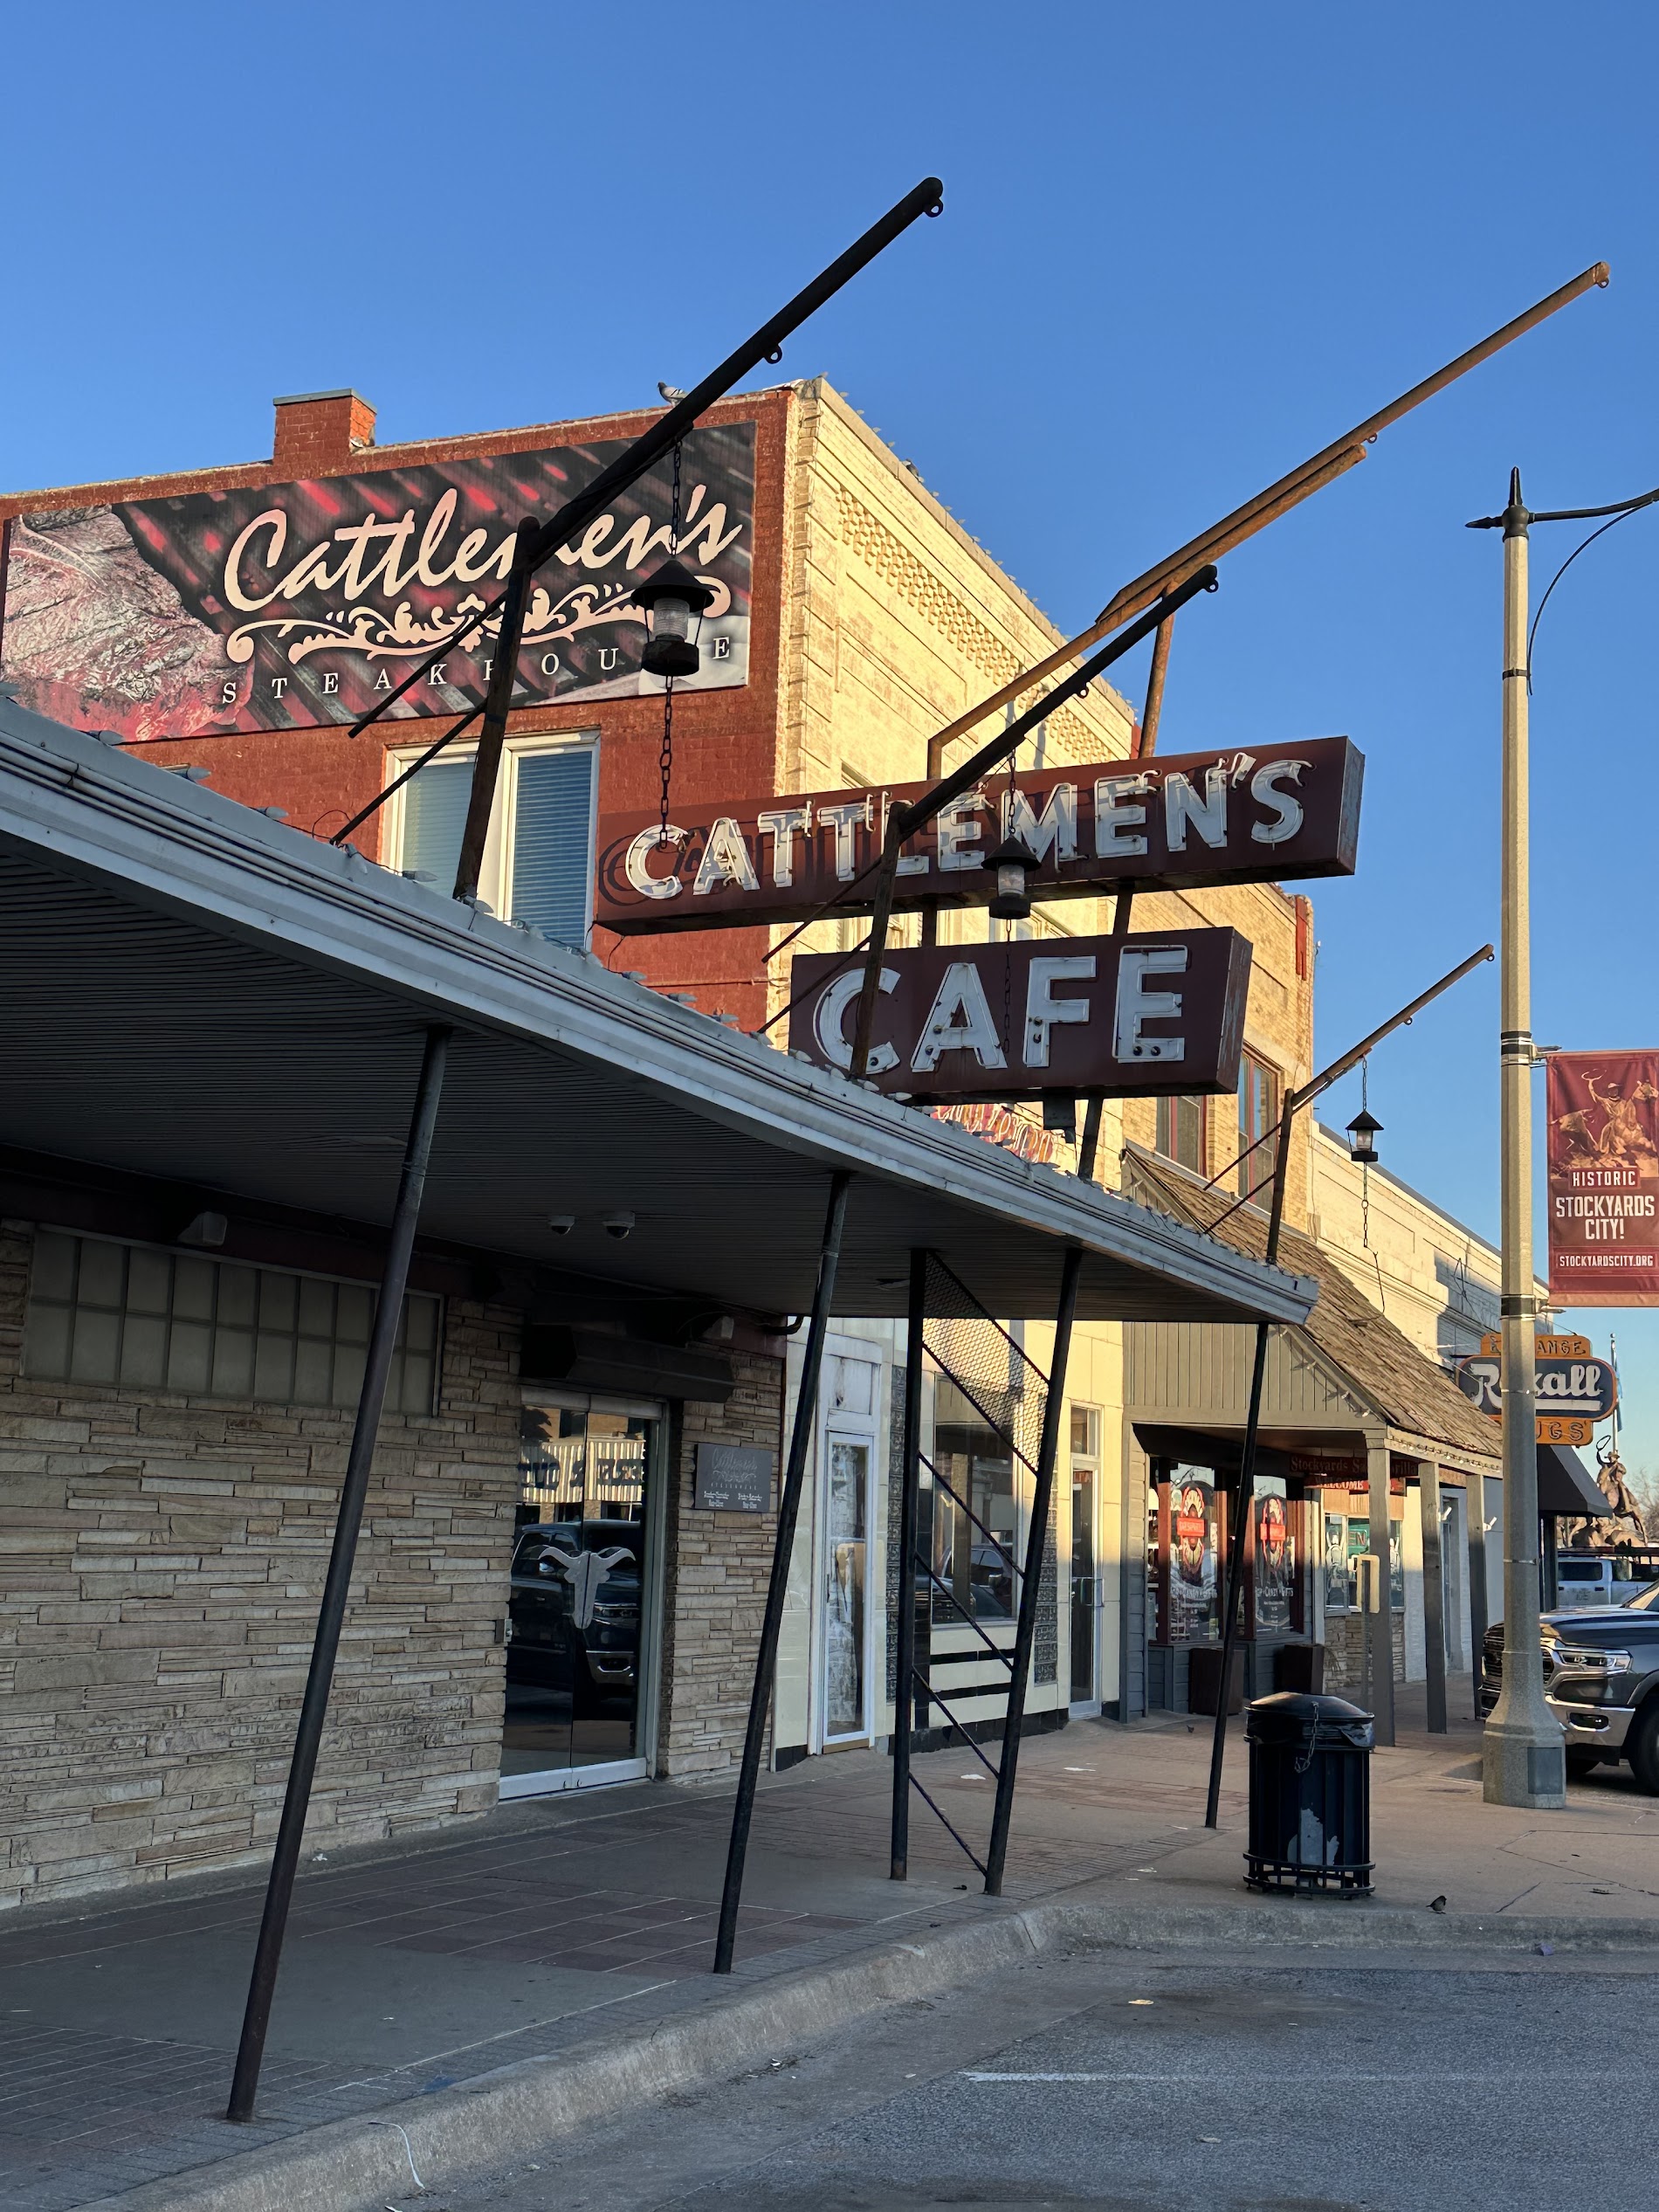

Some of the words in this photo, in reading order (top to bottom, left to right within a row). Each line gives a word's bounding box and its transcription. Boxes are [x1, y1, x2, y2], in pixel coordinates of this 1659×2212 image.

[224, 485, 742, 611] Cattleen's
[222, 637, 730, 704] STEAKOUE
[813, 945, 1188, 1074] CAFE
[1573, 1171, 1635, 1186] HISTORIC
[1555, 1195, 1655, 1217] STOCKYARDS
[1585, 1218, 1624, 1240] CITY!
[1559, 1255, 1654, 1267] STOCKYARDSCITY.ORG
[1470, 1363, 1603, 1409] Rall
[1291, 1454, 1348, 1472] Stockyards
